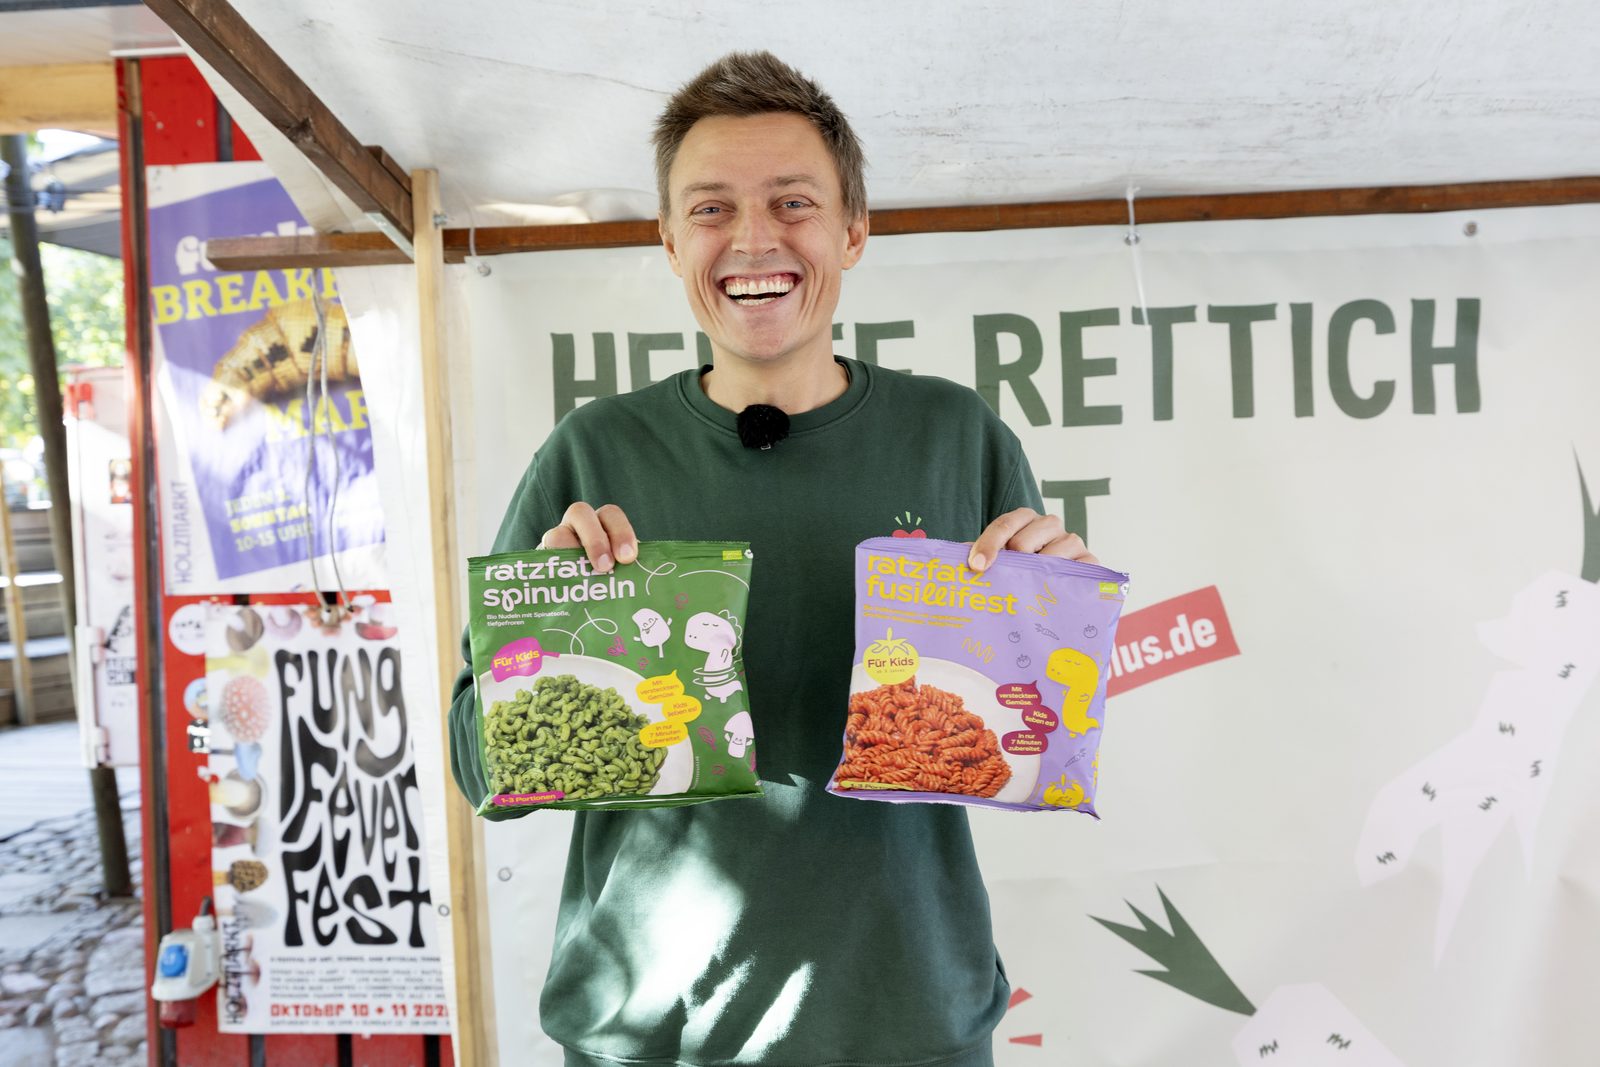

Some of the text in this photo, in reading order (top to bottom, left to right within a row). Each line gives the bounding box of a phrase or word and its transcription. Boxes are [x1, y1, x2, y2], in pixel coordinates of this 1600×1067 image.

[973, 298, 1482, 428] RETTICH
[485, 556, 615, 581] ratzfat.
[483, 577, 636, 612] spinudeln
[866, 575, 1019, 615] fusillifest
[1107, 613, 1218, 682] lus.de
[493, 656, 513, 669] Für
[515, 650, 540, 663] Kids
[867, 657, 914, 668] Für Kids
[1032, 710, 1048, 719] Kids
[515, 794, 556, 802] Portionen
[352, 1003, 369, 1016] 10
[392, 1003, 408, 1017] 11
[413, 1003, 450, 1017] 202
